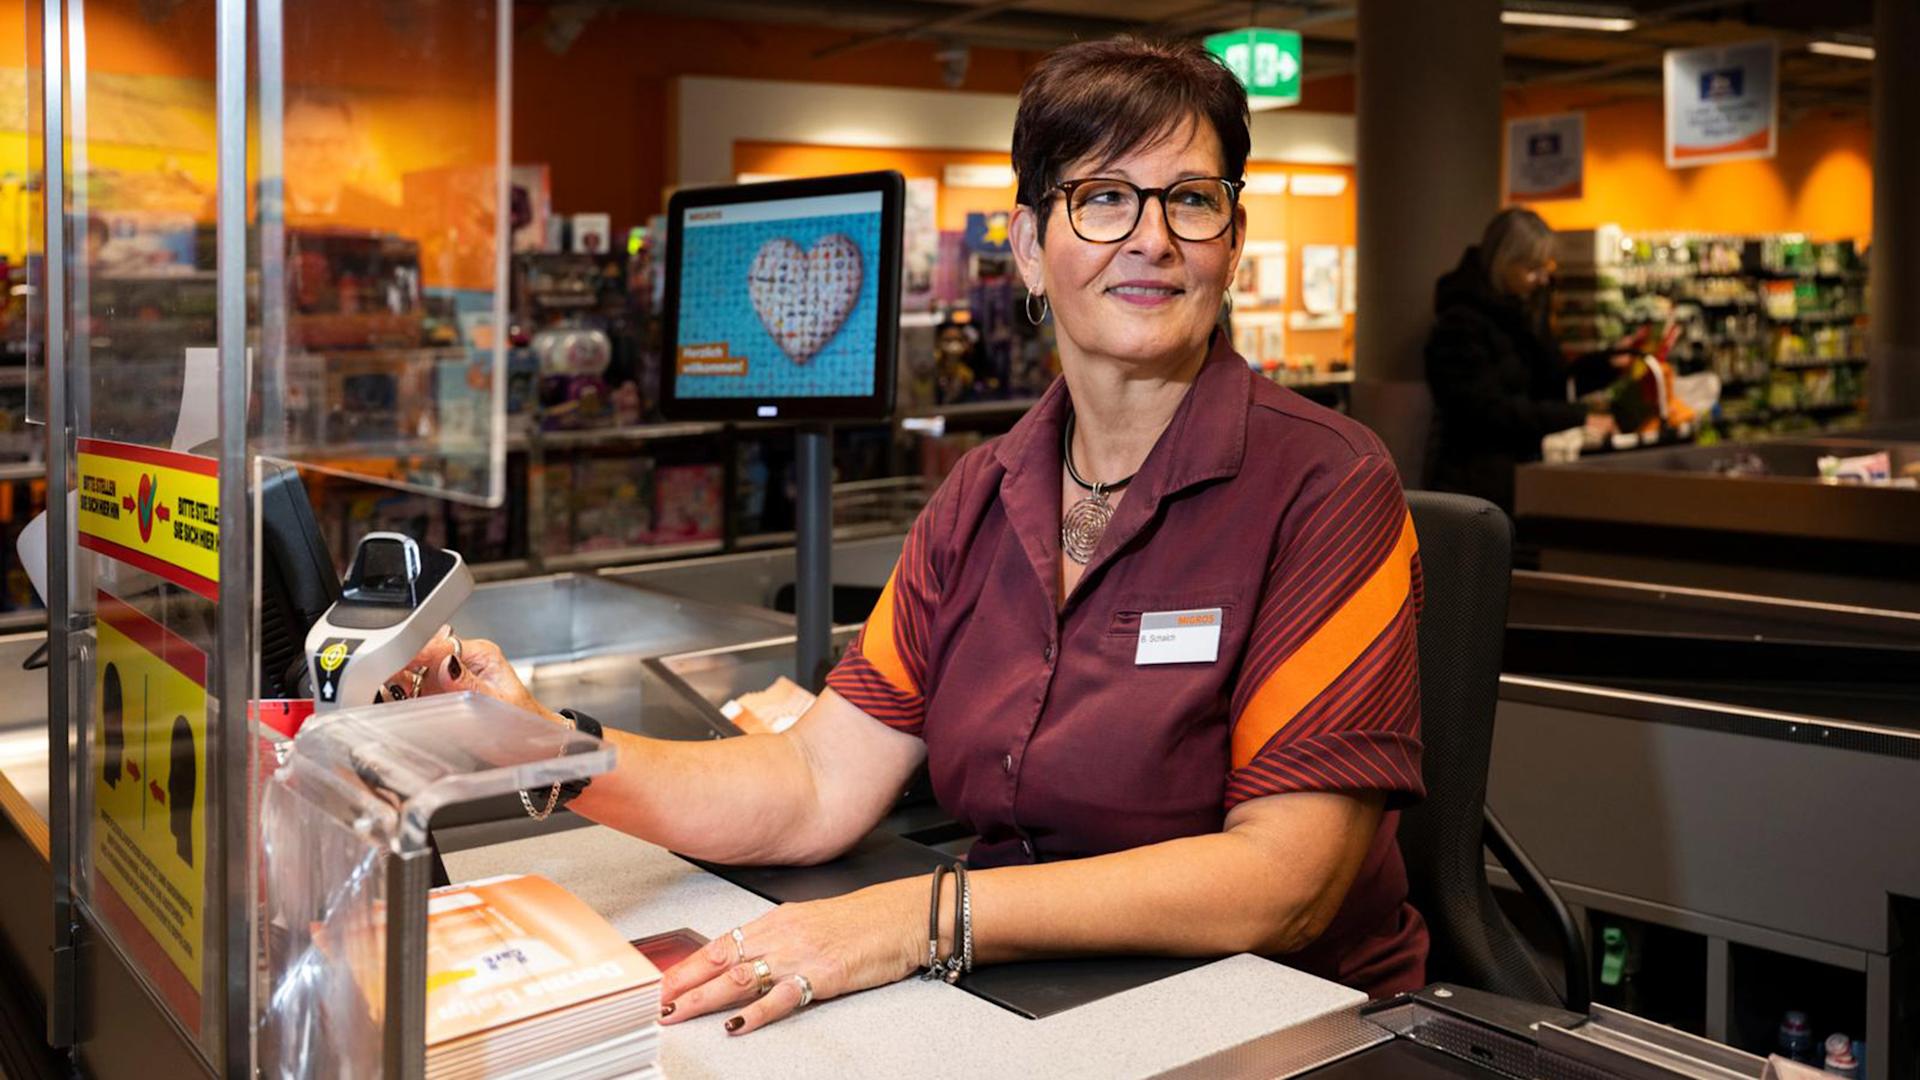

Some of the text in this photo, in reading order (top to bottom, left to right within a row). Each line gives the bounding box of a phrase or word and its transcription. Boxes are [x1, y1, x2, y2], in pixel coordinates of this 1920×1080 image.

[683, 347, 723, 358] Herzlich
[683, 361, 744, 373] willkommen!
[83, 475, 116, 497] BITTE STELLEN
[178, 497, 219, 525] BITTE STELLE
[173, 519, 183, 540] SIE
[184, 522, 199, 545] SICH
[200, 528, 214, 551] HIER
[1178, 615, 1216, 625] MIGROS
